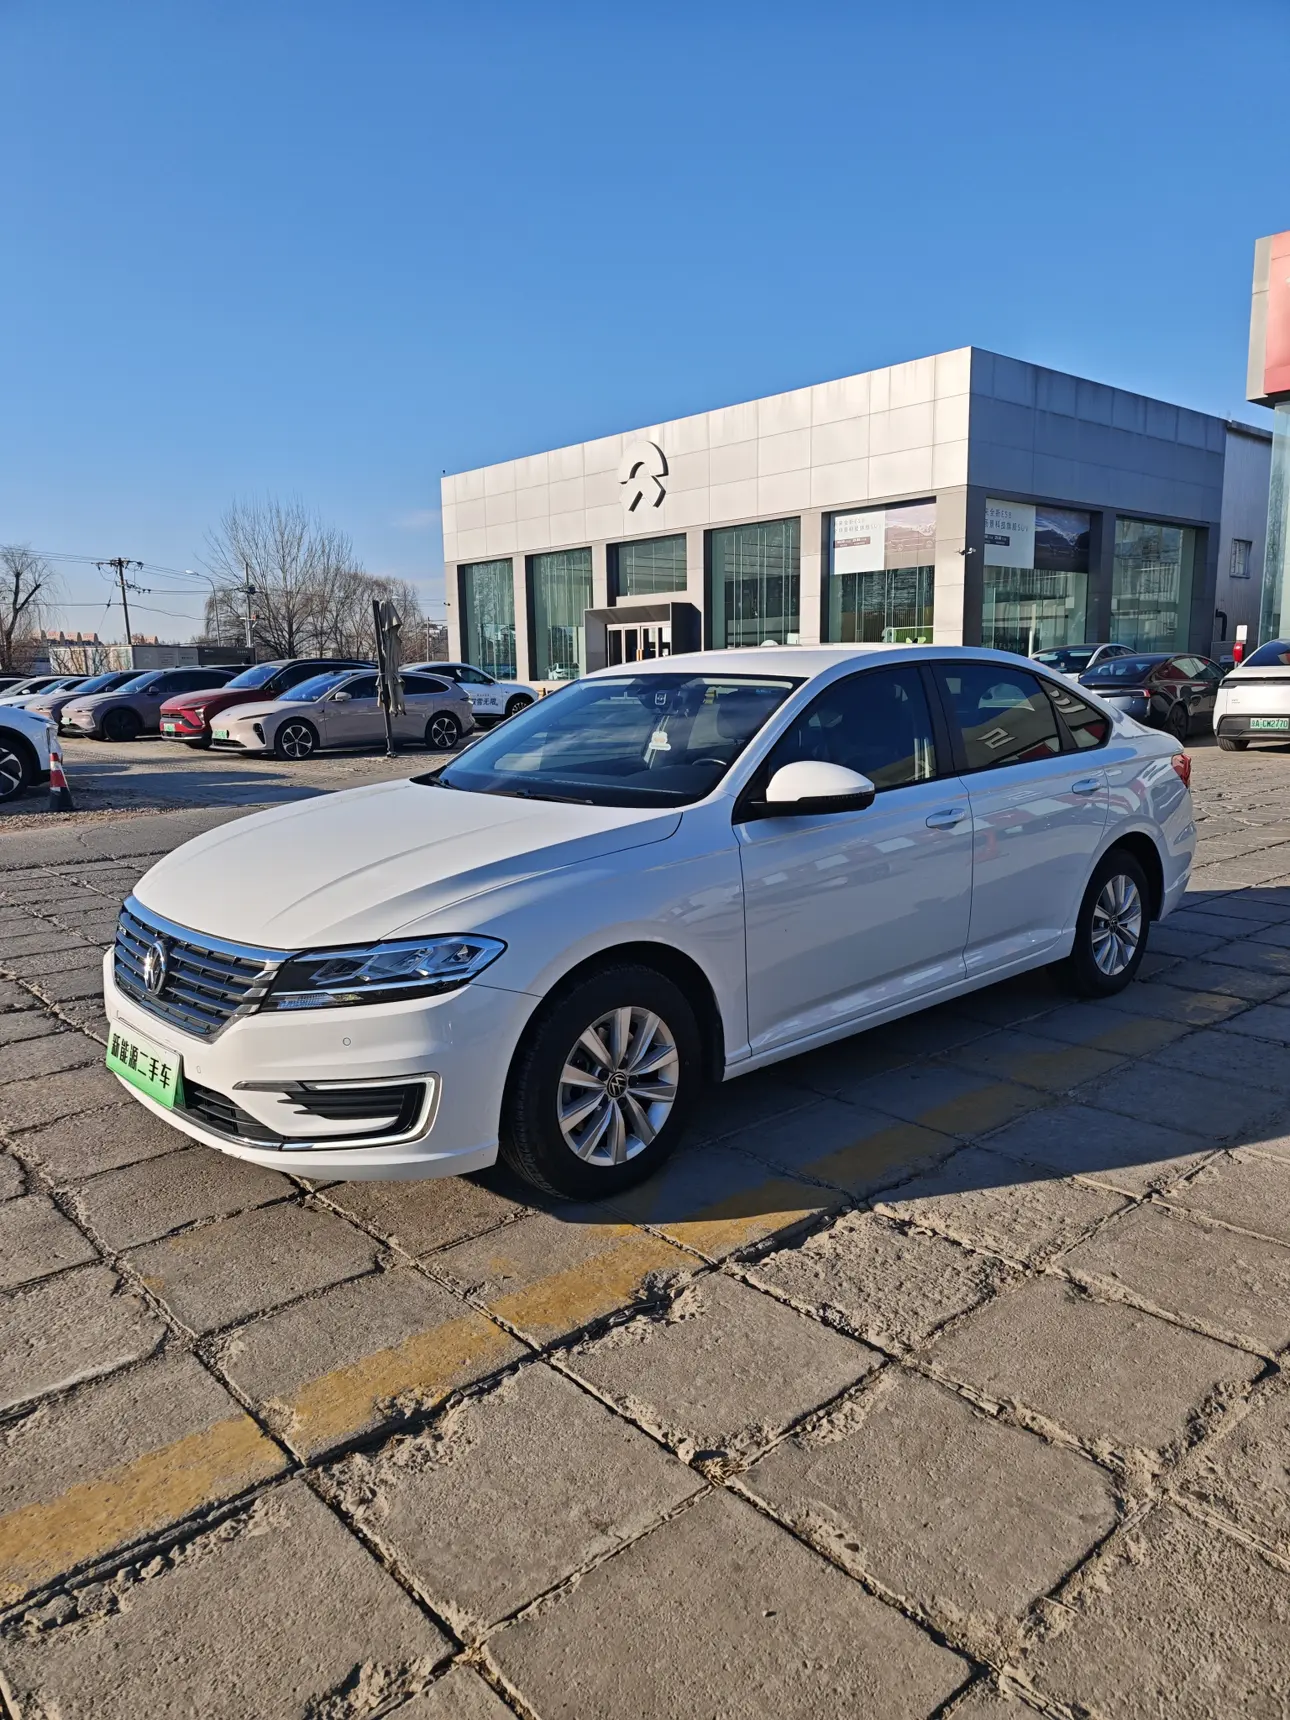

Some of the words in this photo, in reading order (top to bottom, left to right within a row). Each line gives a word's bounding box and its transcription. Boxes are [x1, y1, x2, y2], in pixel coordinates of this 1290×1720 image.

[111, 1033, 172, 1090] 新能源二手车
